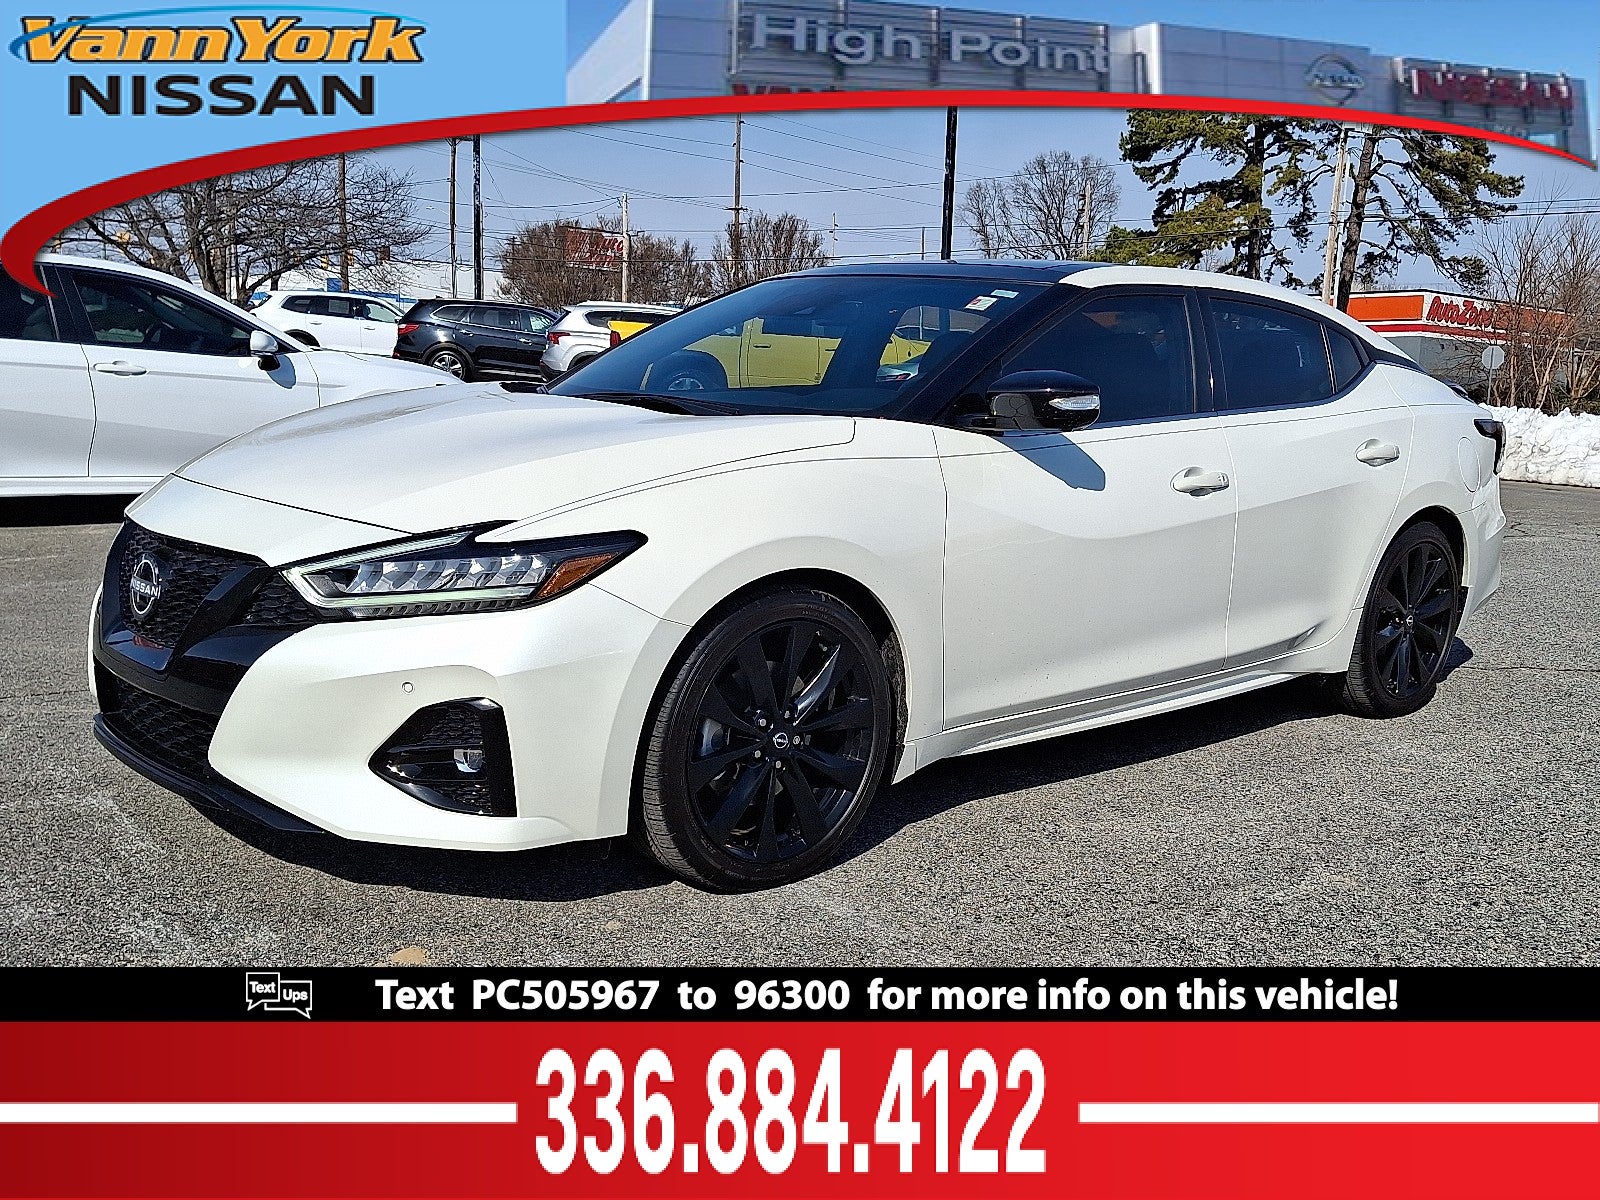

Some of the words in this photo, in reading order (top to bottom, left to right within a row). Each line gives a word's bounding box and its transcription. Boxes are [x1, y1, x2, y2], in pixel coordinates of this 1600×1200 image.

[751, 13, 921, 64] High
[951, 29, 1110, 72] Point
[1426, 296, 1493, 328] AutoZone
[132, 578, 159, 597] NISSAN
